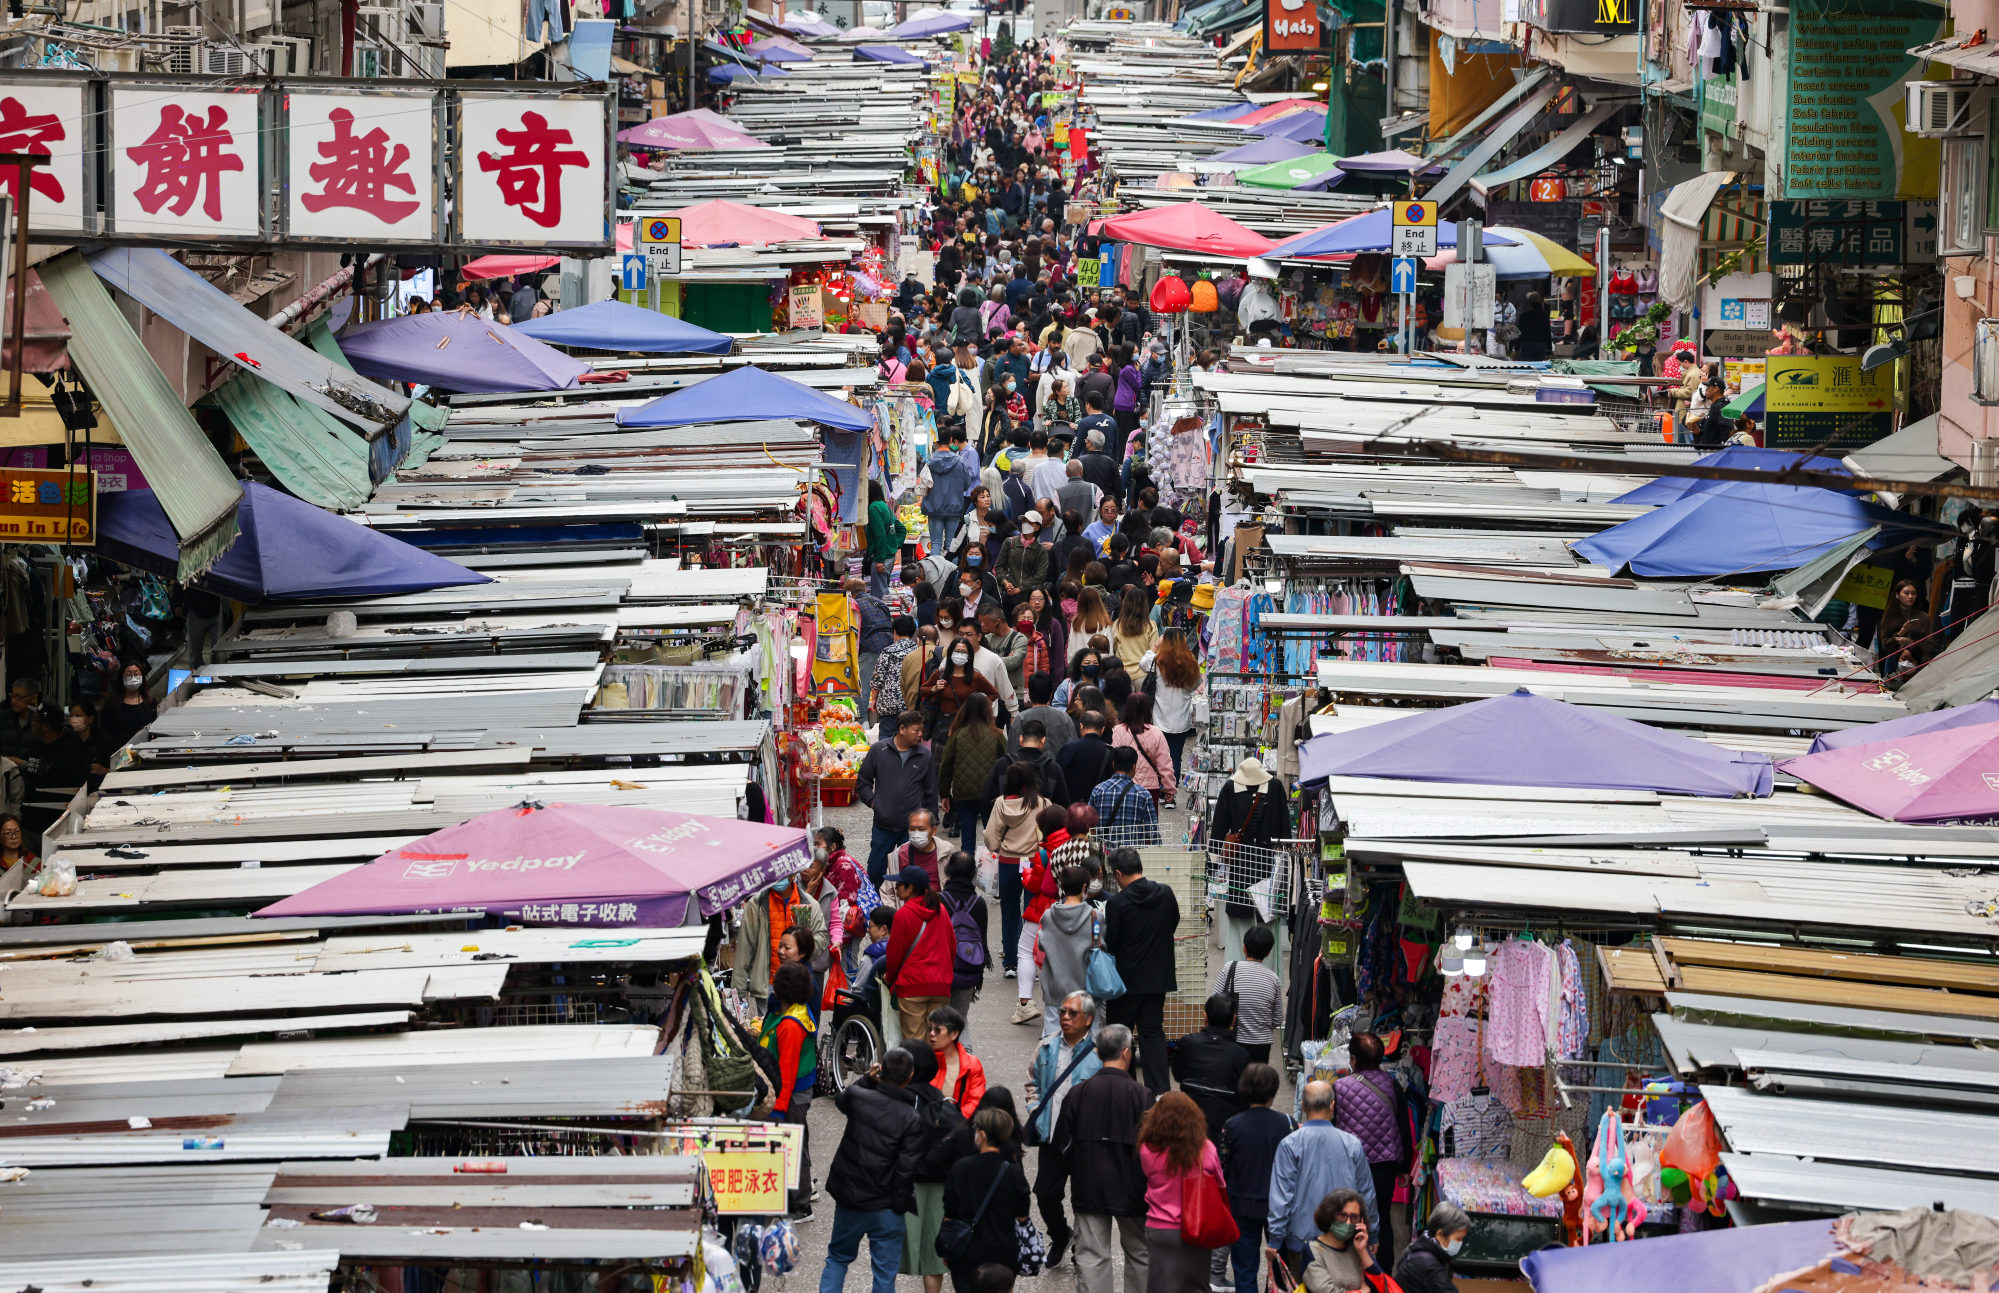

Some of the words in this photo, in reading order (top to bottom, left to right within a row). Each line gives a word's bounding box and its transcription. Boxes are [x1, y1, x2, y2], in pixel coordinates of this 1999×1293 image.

[1795, 38, 1839, 51] Balcony
[1842, 38, 1878, 51] safety
[1794, 52, 1861, 63] Smarthome
[1793, 66, 1841, 77] Curtains
[1855, 66, 1891, 77] blinds
[1793, 80, 1826, 91] Insect
[1827, 82, 1871, 91] screens
[1792, 94, 1815, 105] Sun
[1817, 94, 1857, 105] shades
[1792, 108, 1818, 119] Sofa
[1820, 108, 1858, 119] fabrics
[1791, 122, 1847, 133] Insulation
[1850, 122, 1878, 133] films
[1791, 136, 1832, 149] Folding
[1835, 138, 1878, 147] screens
[1790, 150, 1832, 161] Interior
[1835, 150, 1878, 161] finishes
[1790, 164, 1823, 175] Fabric
[1826, 164, 1880, 177] partitions
[1790, 178, 1814, 189] Soft
[1816, 178, 1841, 189] cells
[1844, 178, 1882, 189] fabrics
[1405, 229, 1425, 238] End
[1778, 227, 1894, 253] 醫療用品
[649, 246, 669, 255] End
[1401, 241, 1427, 252] 終止
[1661, 320, 1671, 340] BRA
[1724, 333, 1742, 341] Bute
[1744, 333, 1769, 342] Street
[104, 452, 127, 464] Shop
[27, 520, 46, 534] In
[52, 521, 87, 535] Lfe
[466, 852, 583, 874] Yedpay
[503, 903, 638, 923] 一站式電子收款
[711, 1168, 778, 1195] 肥肥泳衣
